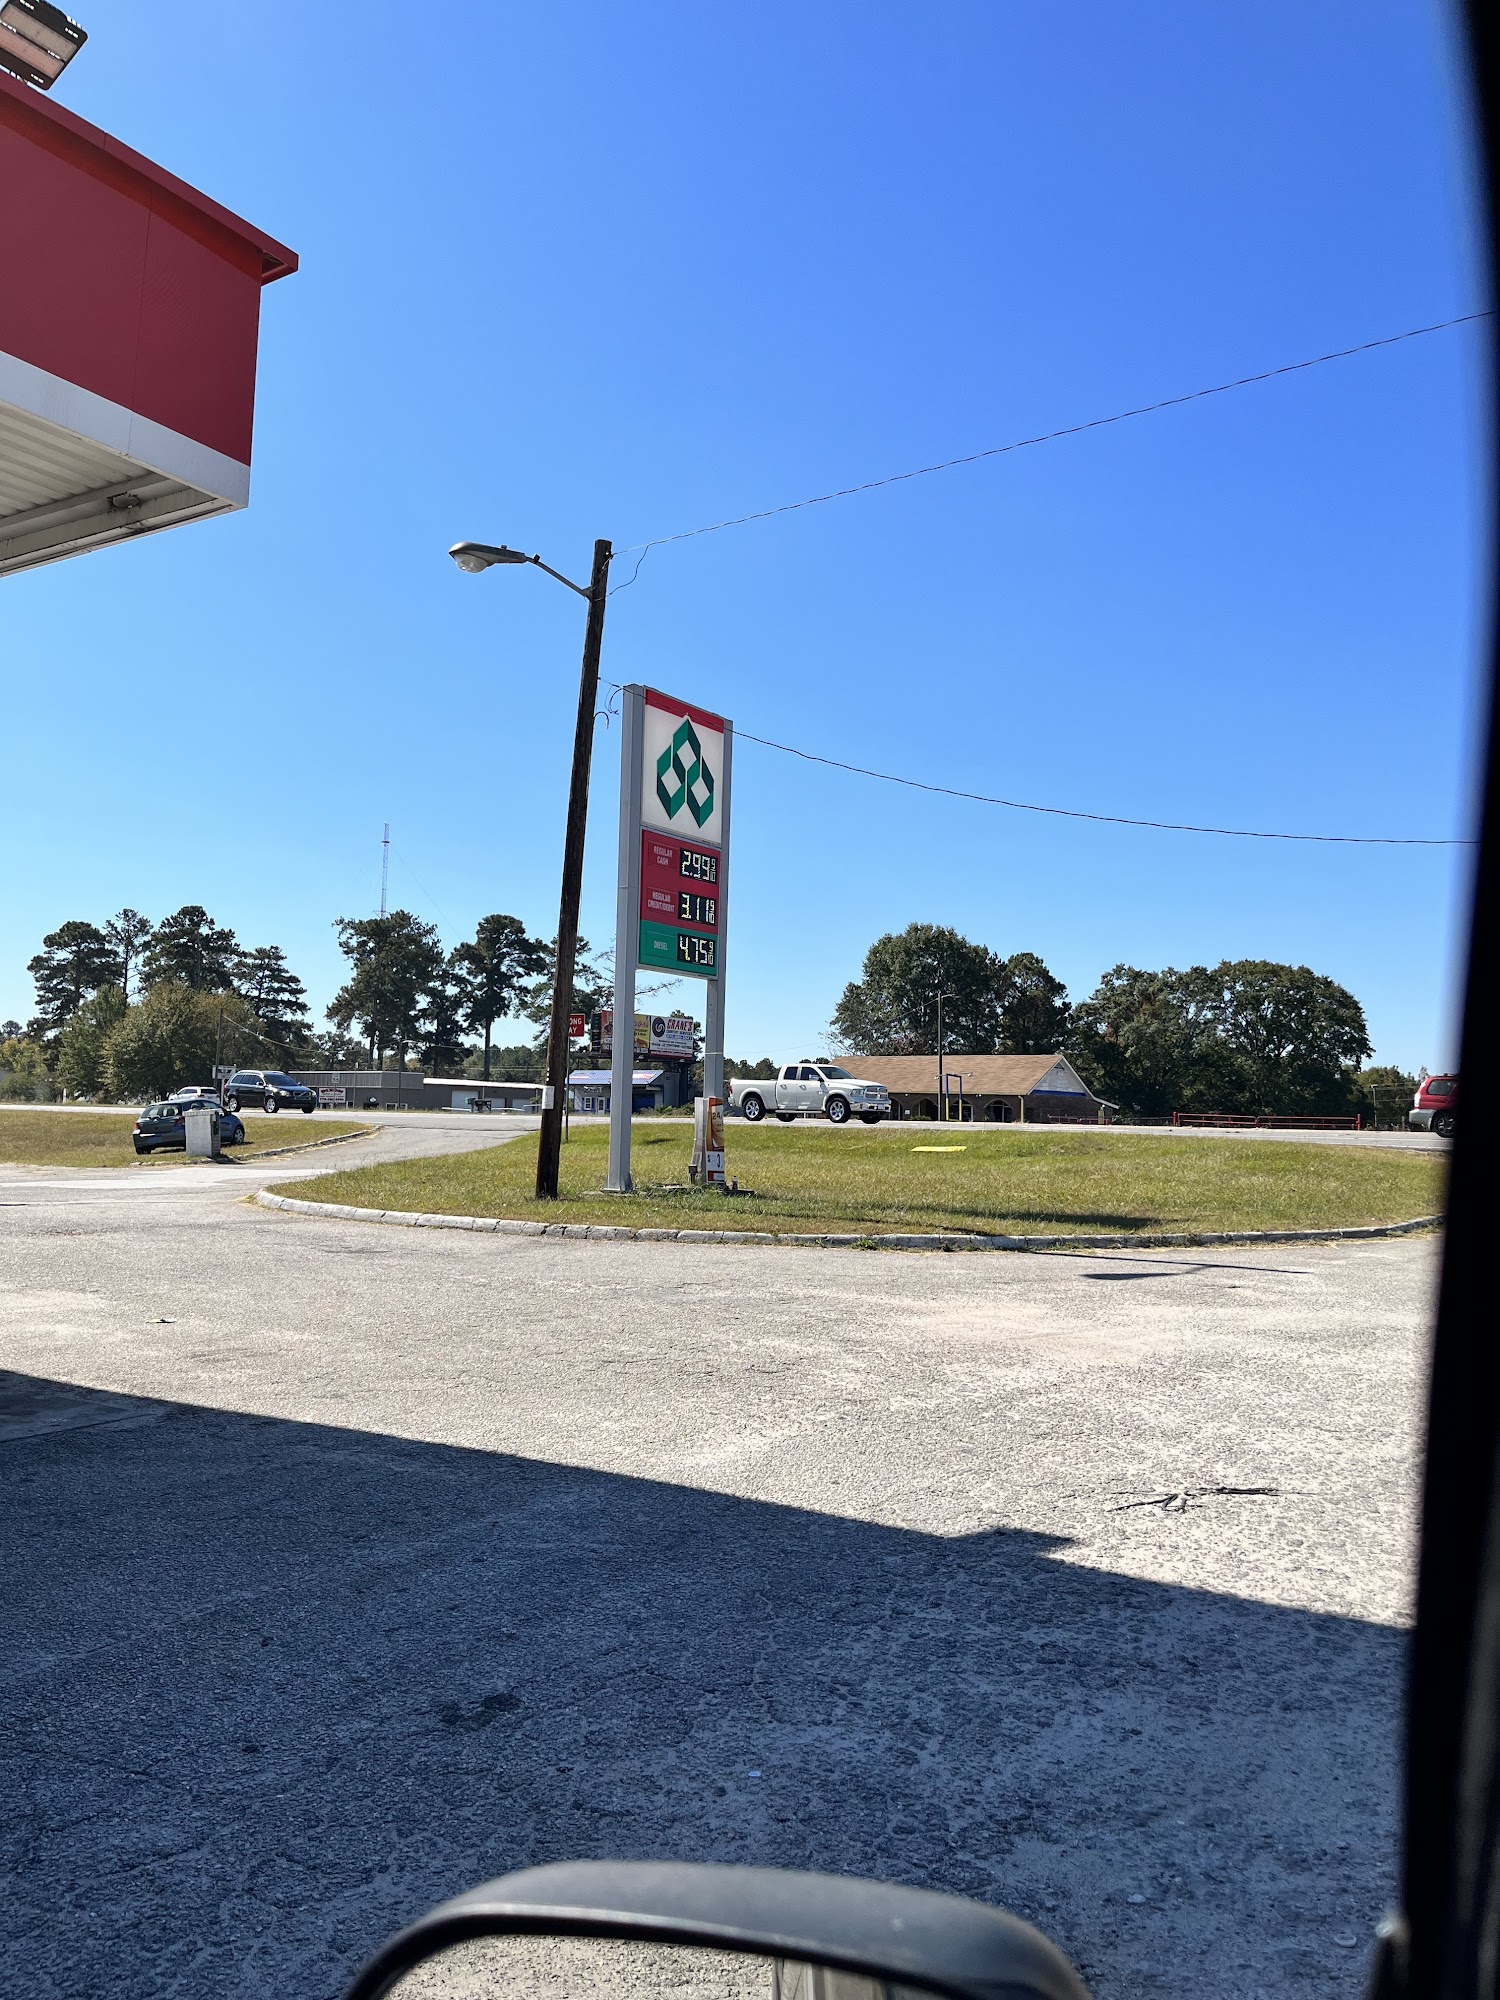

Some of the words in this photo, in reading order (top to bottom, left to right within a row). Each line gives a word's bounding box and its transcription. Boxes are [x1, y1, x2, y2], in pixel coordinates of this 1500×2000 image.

[653, 845, 673, 859] REGULAR
[656, 856, 669, 866] CASH
[681, 850, 710, 881] 2.99
[652, 891, 671, 902] REGULAR
[653, 940, 669, 951] DIESEL
[569, 1017, 582, 1025] ONG
